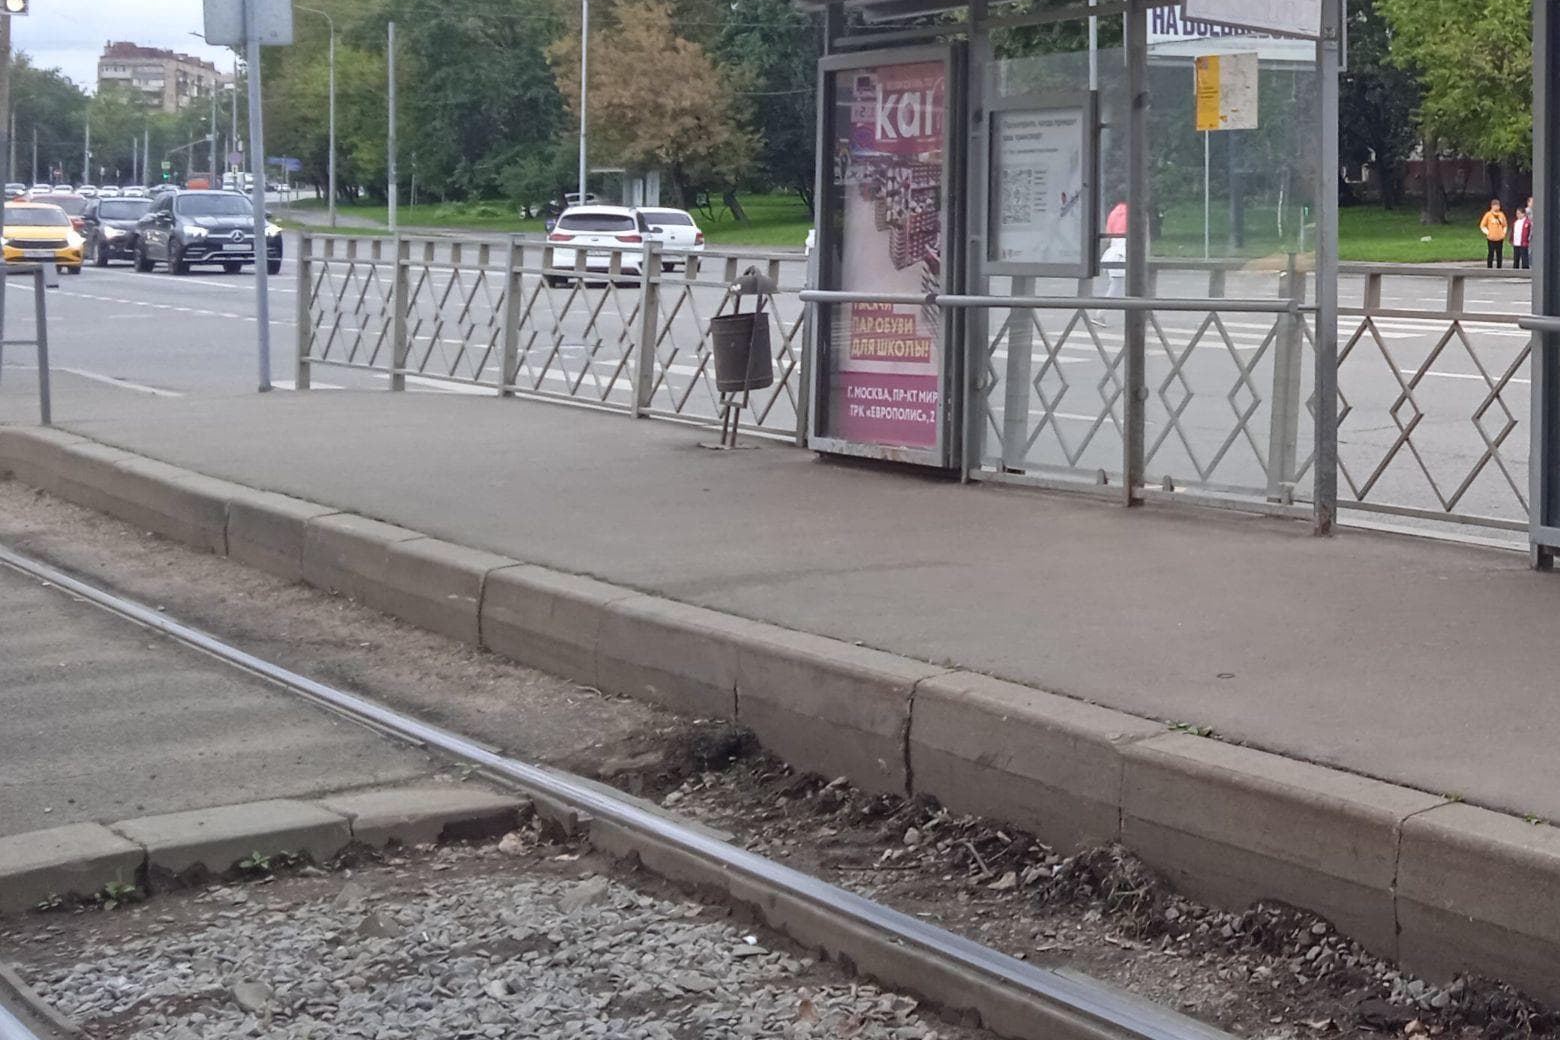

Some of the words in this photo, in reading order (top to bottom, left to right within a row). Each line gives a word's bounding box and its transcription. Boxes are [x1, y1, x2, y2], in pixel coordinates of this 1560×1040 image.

[1152, 7, 1179, 35] НА
[854, 317, 872, 333] ПАР
[875, 317, 914, 335] ОБУВИ
[852, 339, 875, 357] ДЛЯ
[877, 340, 929, 357] ШКОЛЫ!
[854, 387, 892, 402] МОСКВА,
[893, 389, 918, 403] ПР-КТ
[850, 404, 865, 418] ТРК
